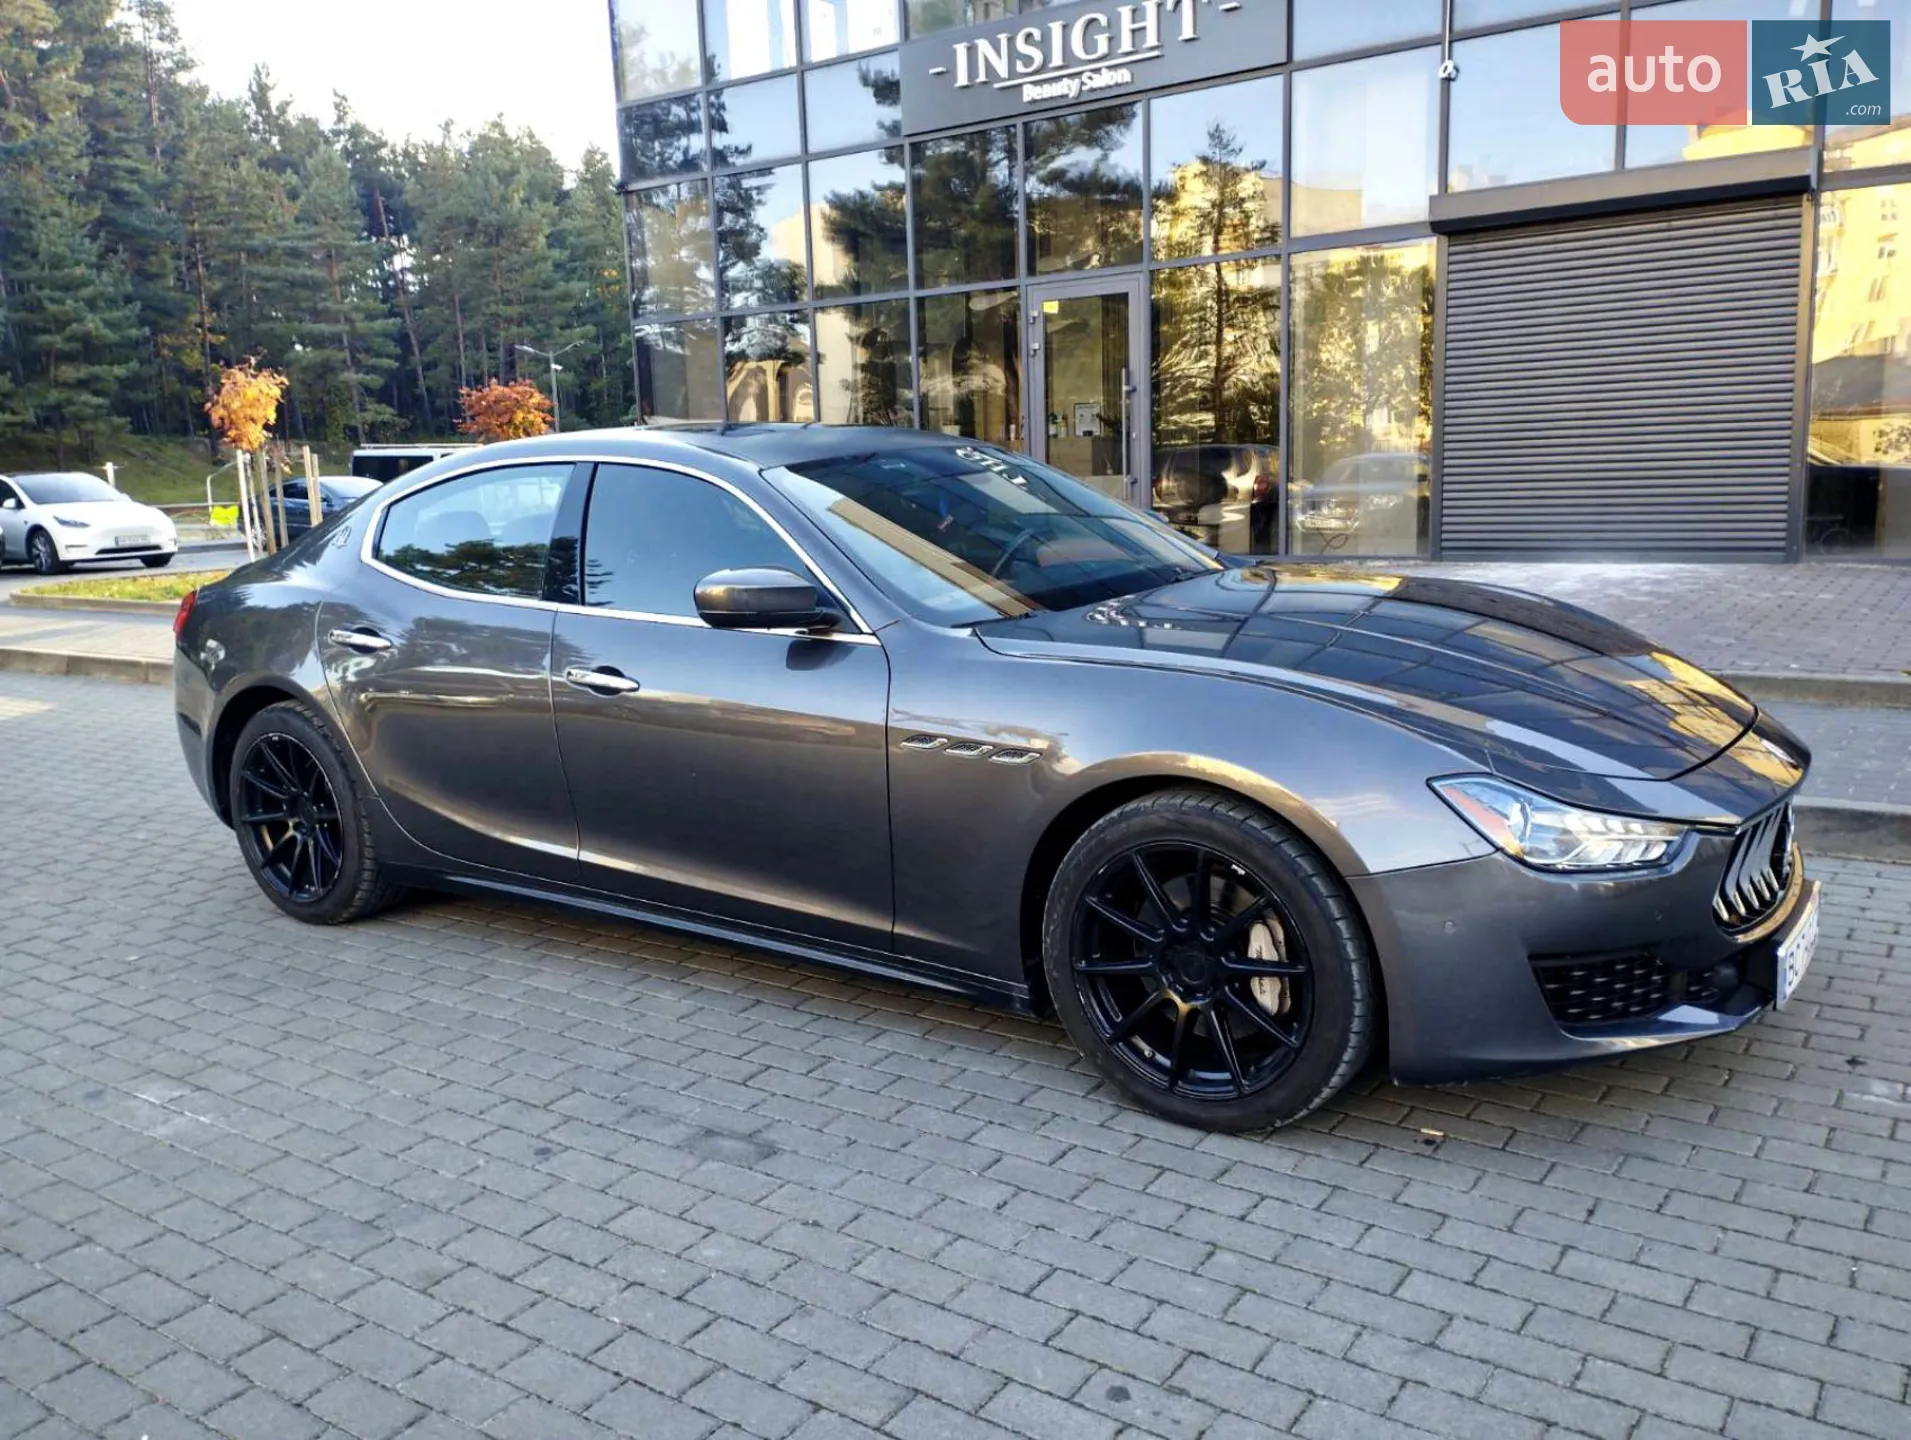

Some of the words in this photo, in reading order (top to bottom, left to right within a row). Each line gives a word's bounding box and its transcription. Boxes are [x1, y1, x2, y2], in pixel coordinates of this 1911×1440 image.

[953, 0, 1207, 87] INSIGHT
[1022, 77, 1081, 103] Beauty
[1081, 66, 1132, 91] Salon
